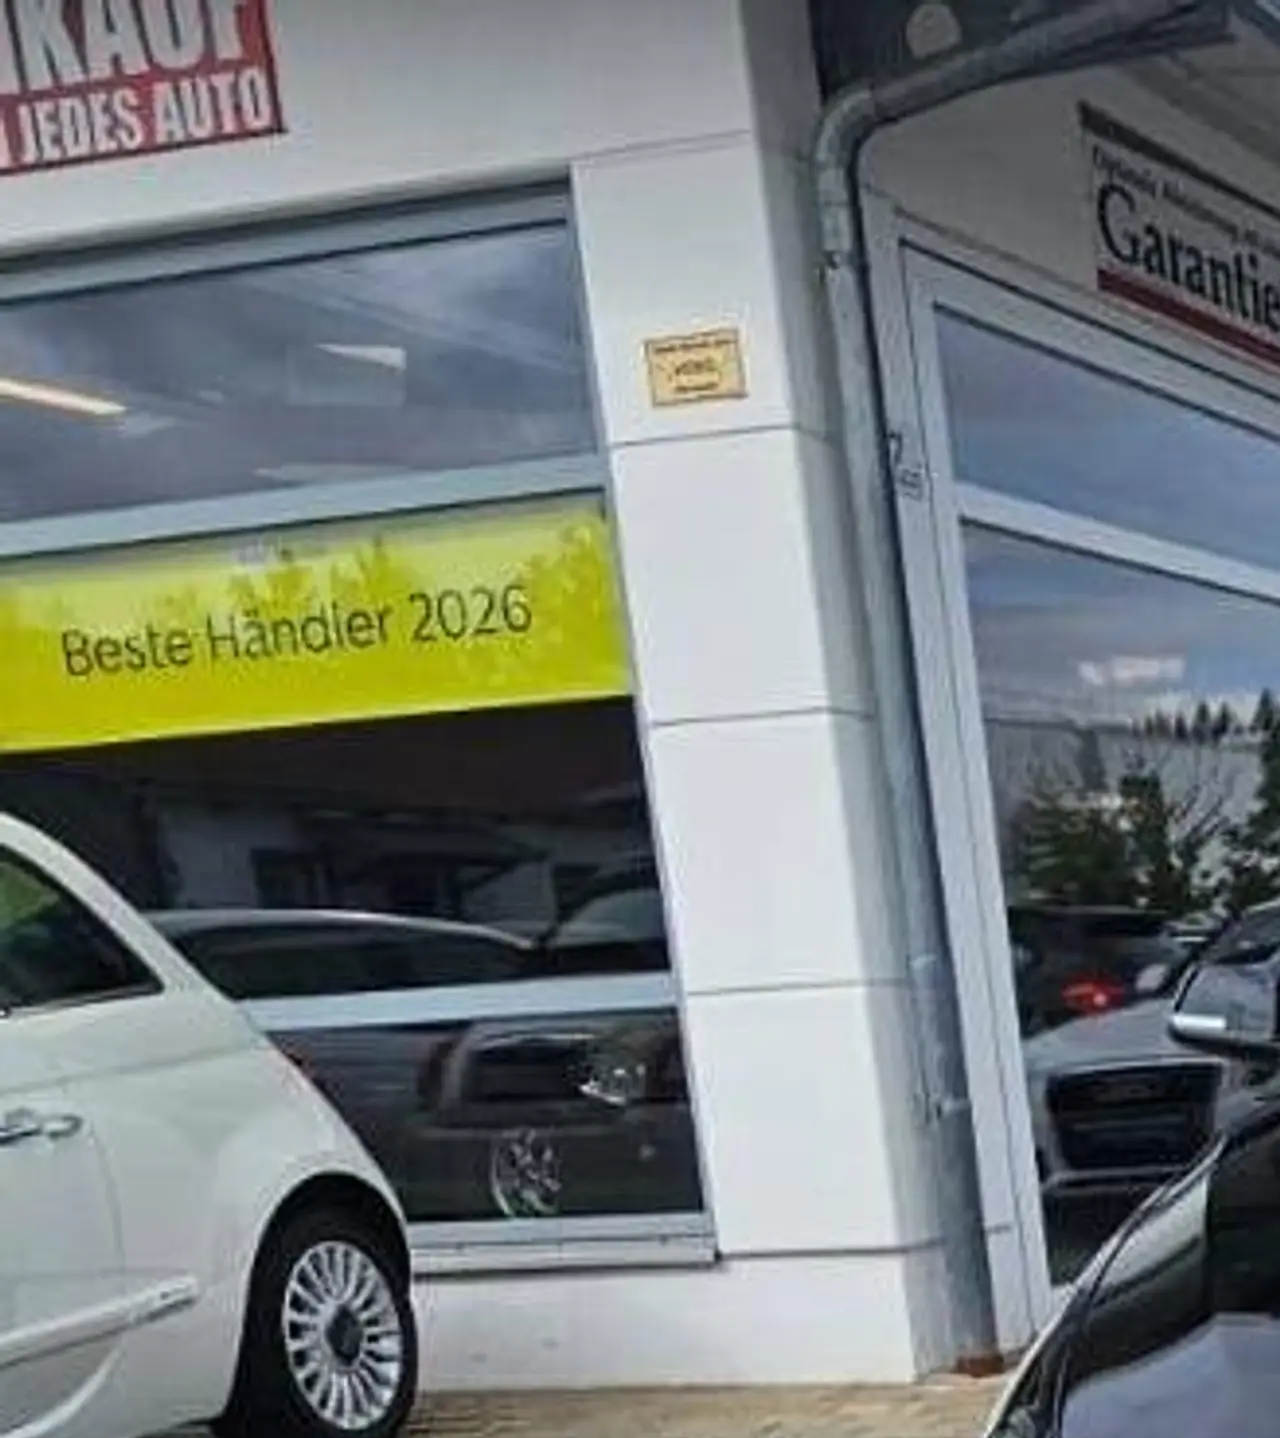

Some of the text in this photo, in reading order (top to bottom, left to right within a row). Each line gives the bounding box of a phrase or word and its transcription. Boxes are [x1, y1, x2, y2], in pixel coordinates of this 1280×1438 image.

[17, 87, 144, 164] JEDES
[151, 66, 273, 143] AUTO
[62, 584, 534, 677] Beste Händler 2026
